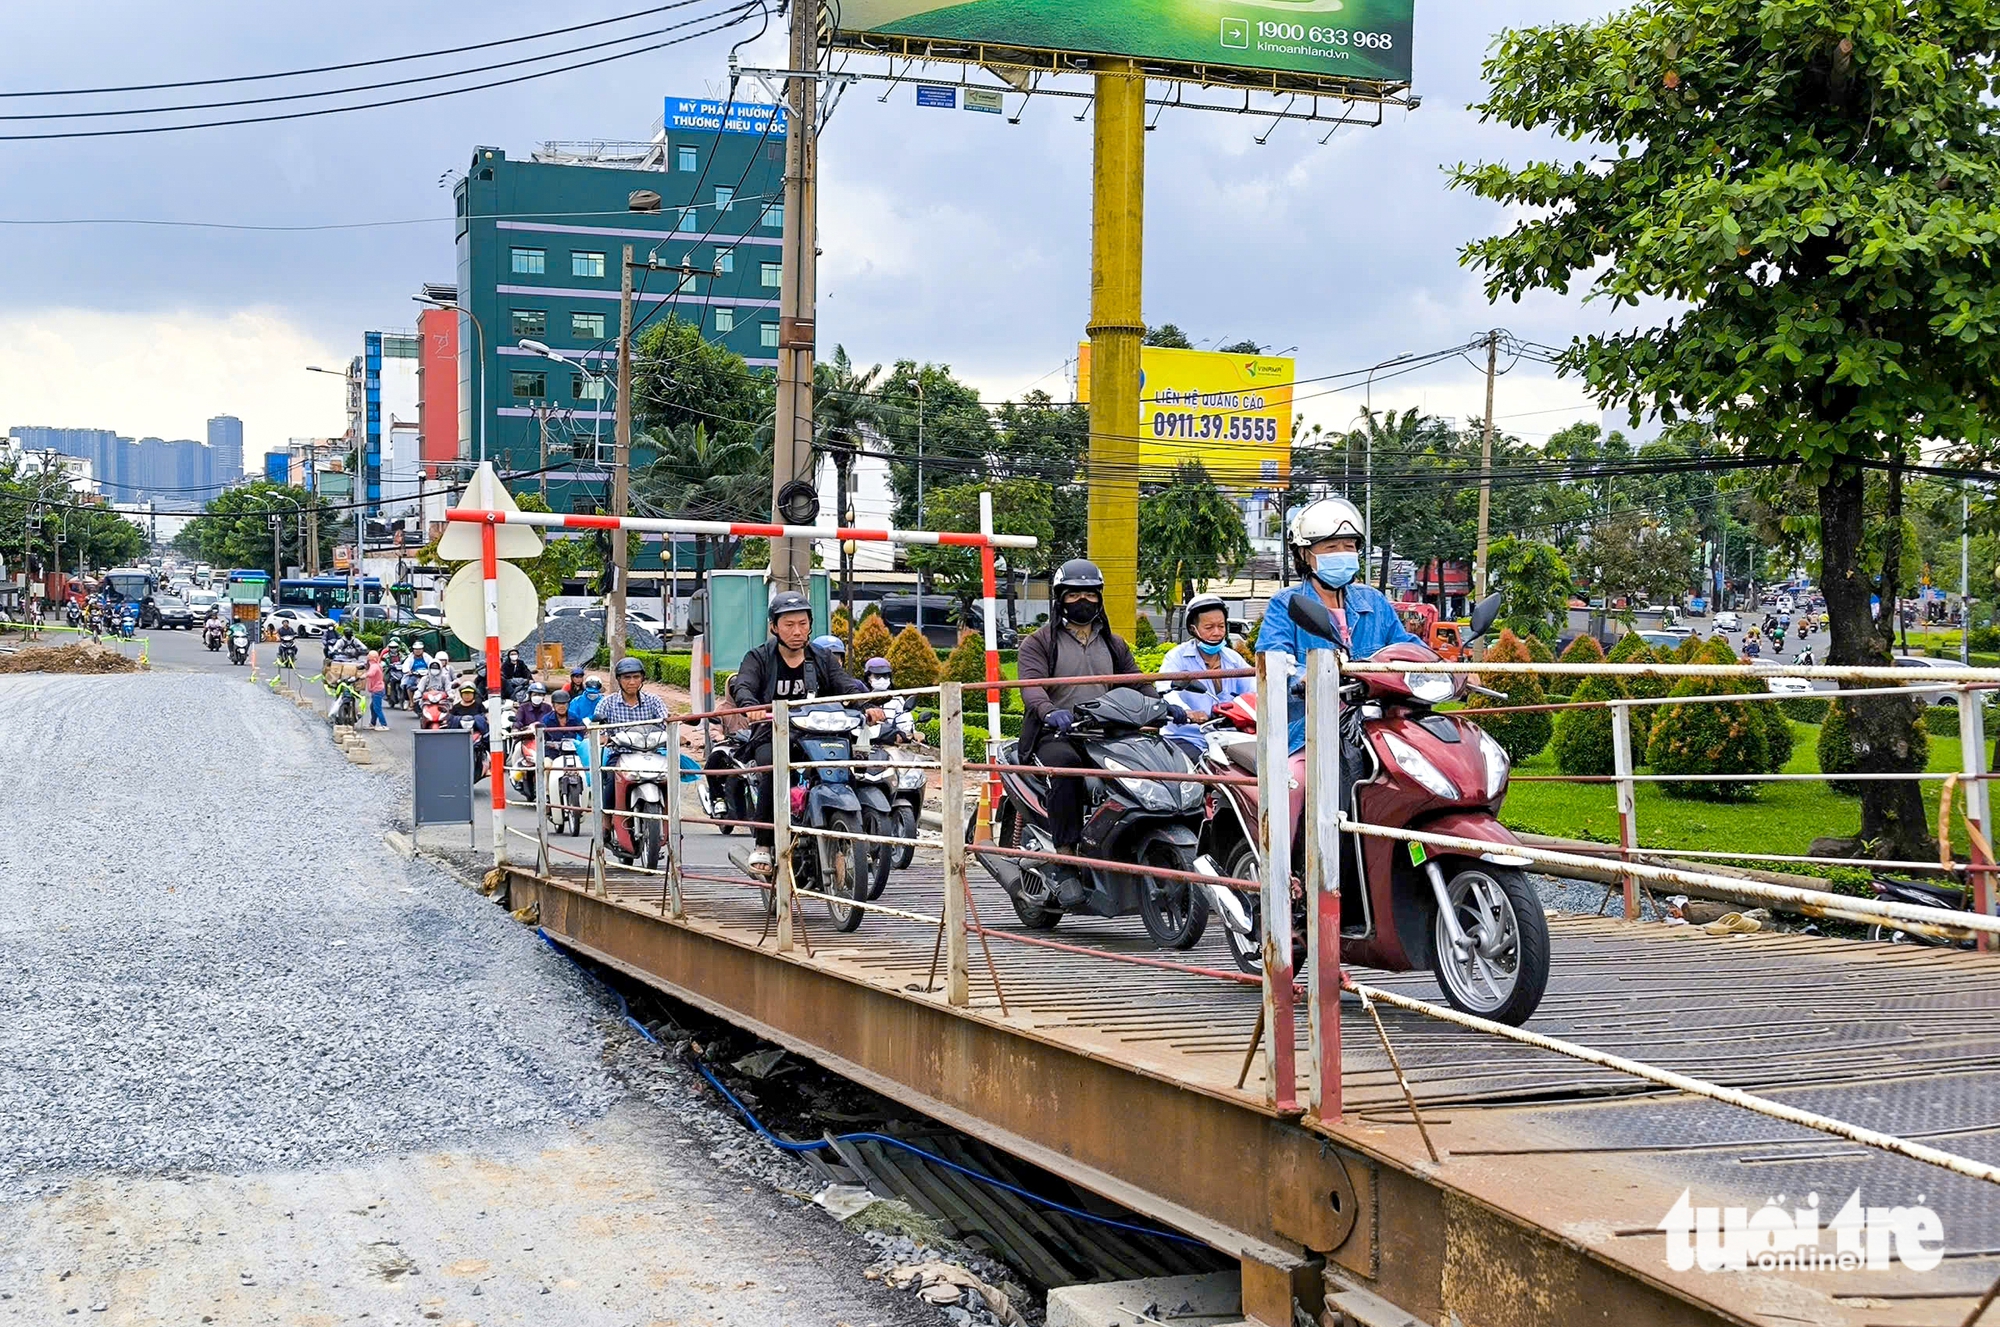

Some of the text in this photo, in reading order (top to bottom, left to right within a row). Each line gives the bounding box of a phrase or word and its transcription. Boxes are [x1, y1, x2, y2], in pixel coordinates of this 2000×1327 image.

[1256, 21, 1393, 50] 1900 633 968
[1257, 41, 1349, 59] kimoanhland.vn
[679, 100, 697, 113] MỸ
[673, 116, 720, 129] THƯƠNG
[725, 118, 751, 133] HIỆU
[1155, 388, 1180, 404] LIÊN
[1184, 389, 1198, 409] HỆ
[1243, 394, 1264, 409] CÁO
[1154, 412, 1276, 441] 0911.39.5555
